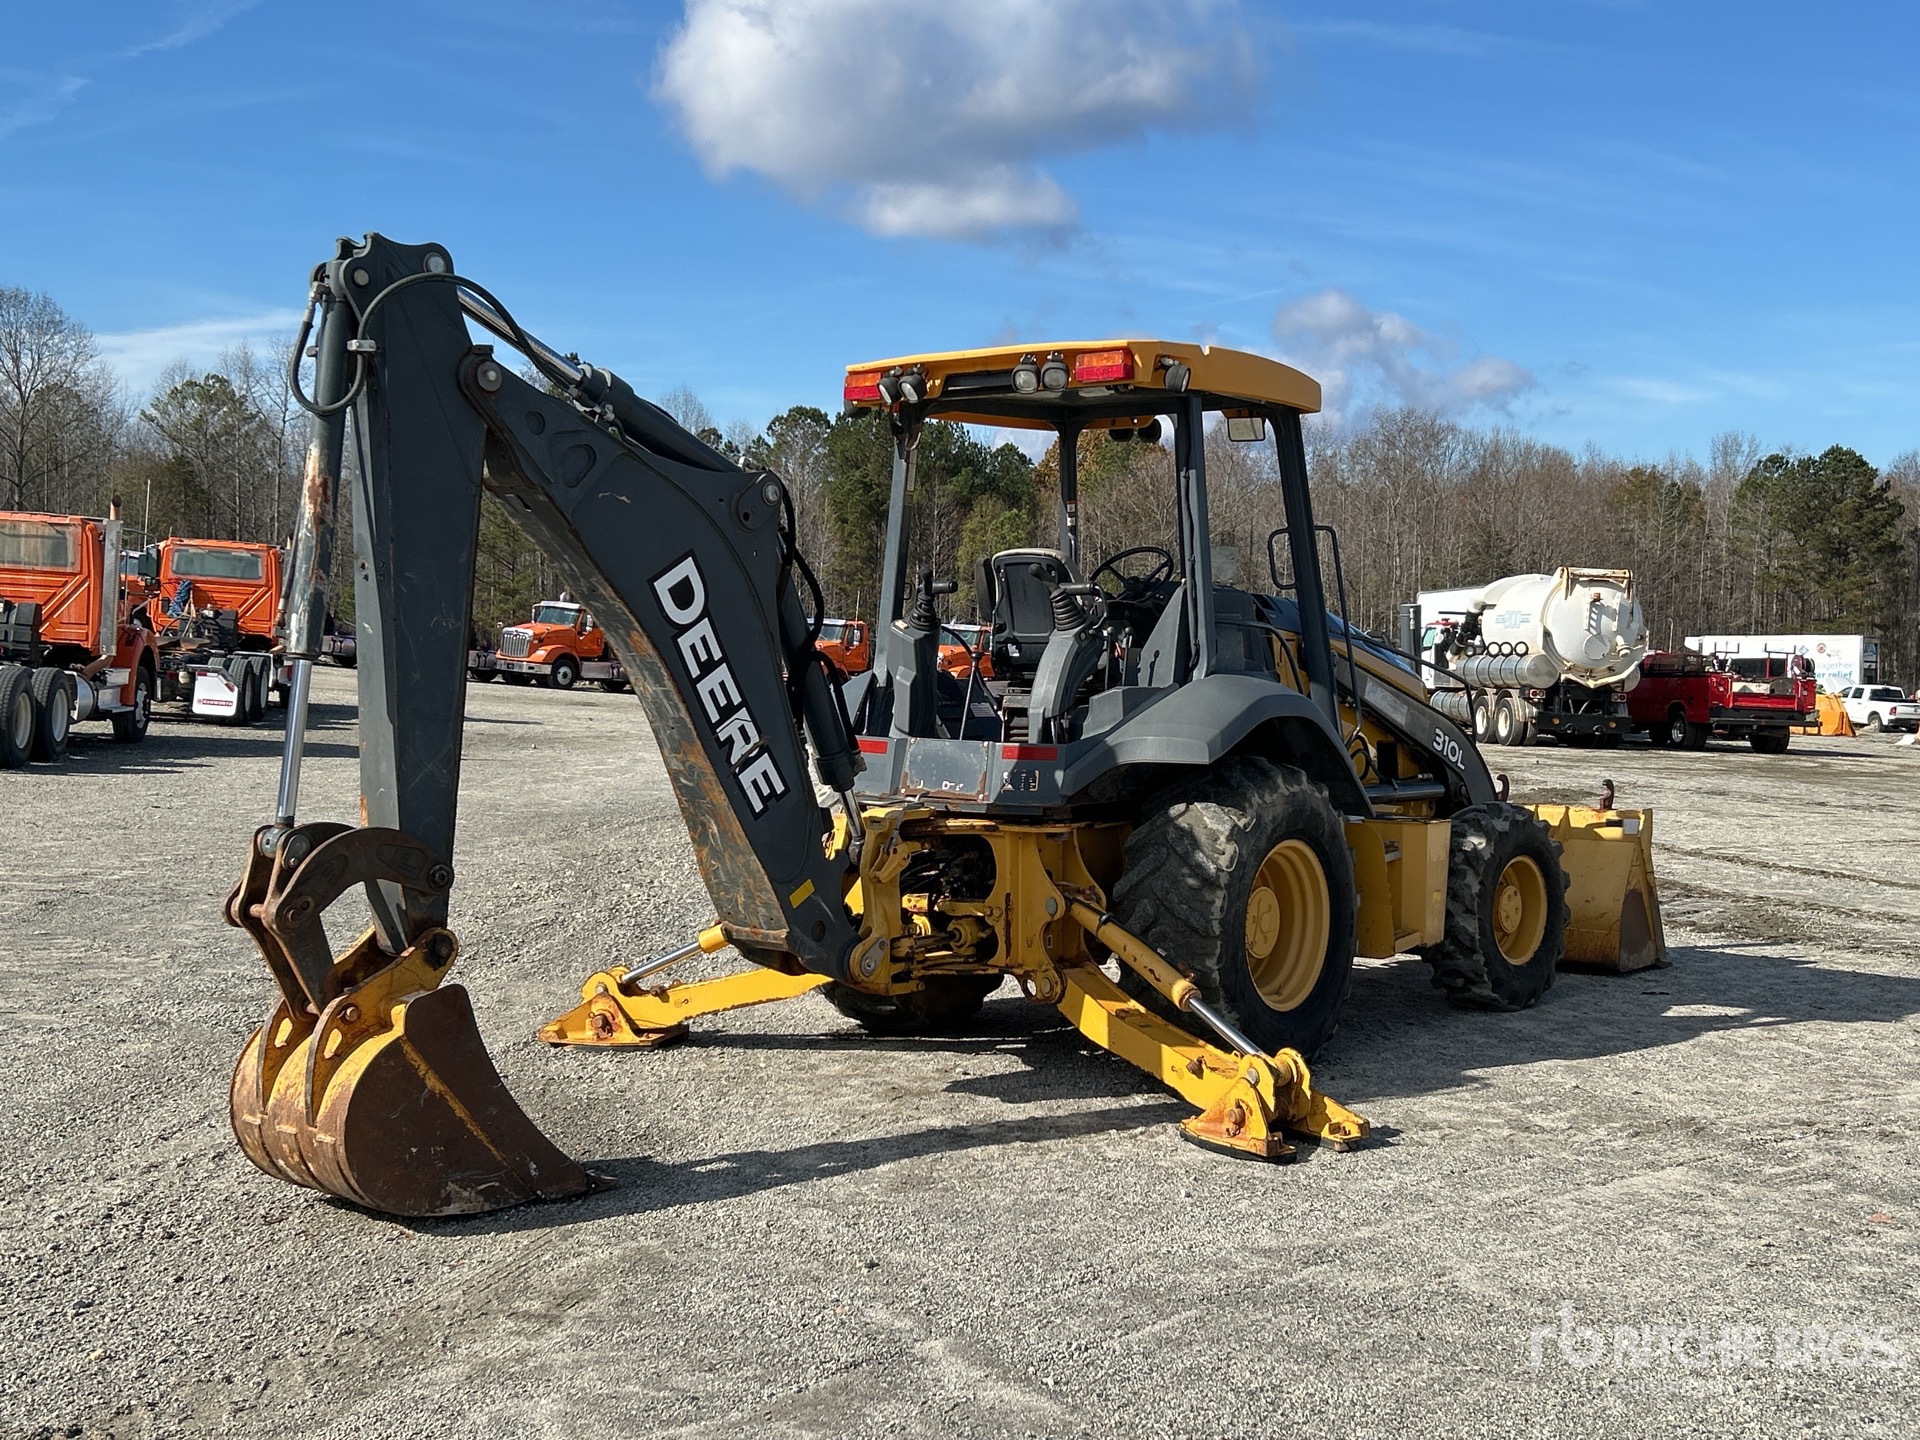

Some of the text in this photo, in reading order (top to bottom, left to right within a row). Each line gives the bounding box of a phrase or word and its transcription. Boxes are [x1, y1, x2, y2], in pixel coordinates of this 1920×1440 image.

[653, 556, 787, 814] DEERE
[1828, 670, 1853, 679] relief
[1432, 728, 1466, 770] 310L
